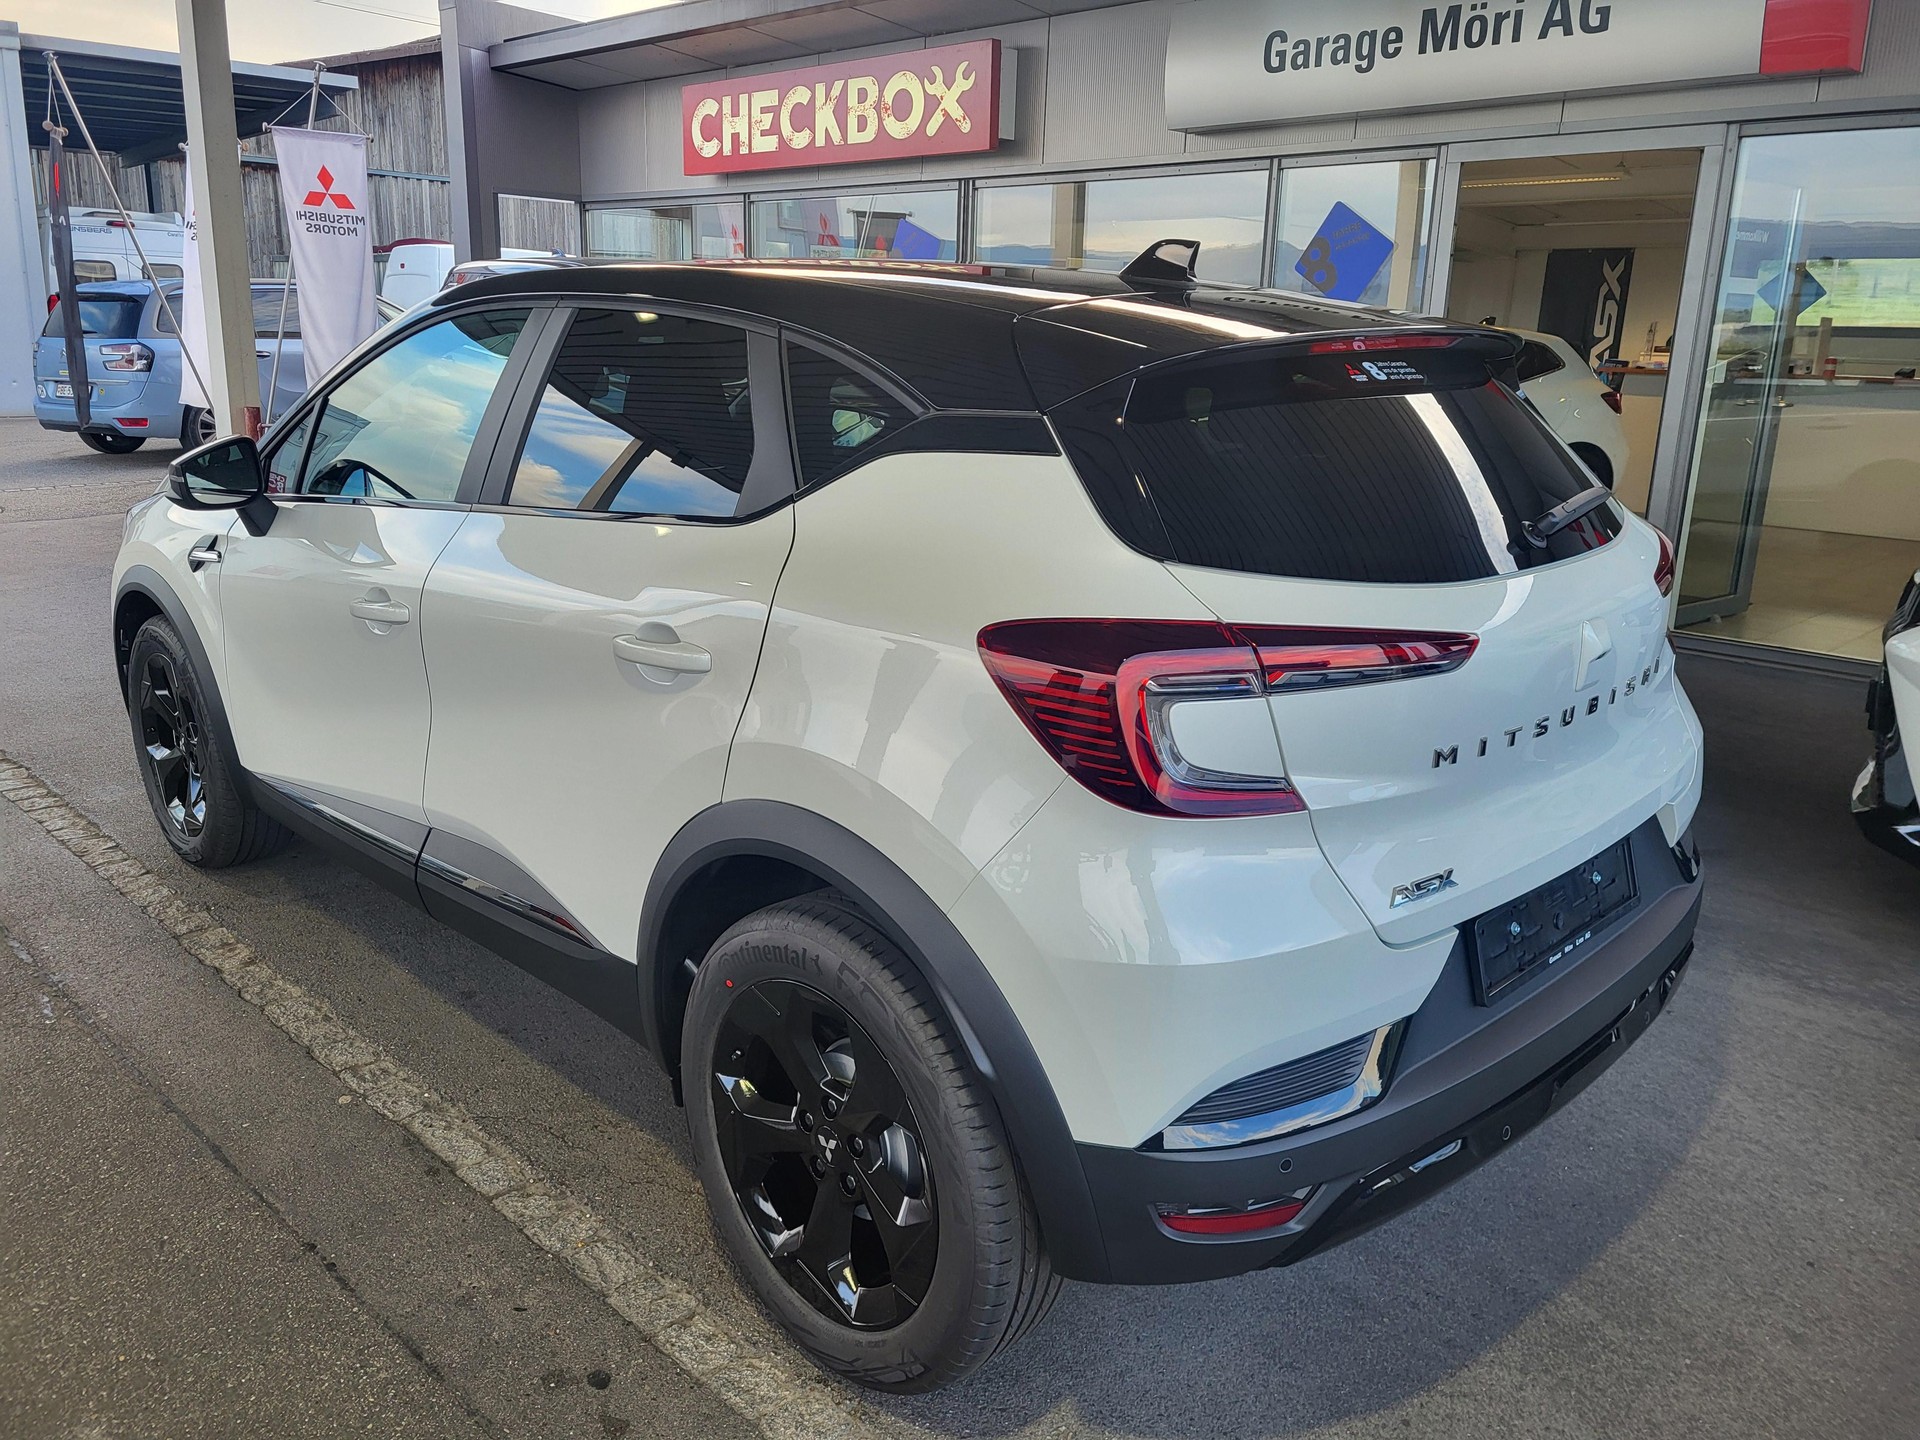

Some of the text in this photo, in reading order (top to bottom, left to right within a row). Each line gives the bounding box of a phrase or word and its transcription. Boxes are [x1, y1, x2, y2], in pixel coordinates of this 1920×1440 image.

[1263, 0, 1613, 74] Garage Möri AG
[691, 61, 976, 158] CHECKBOX
[1301, 236, 1337, 293] 8
[1589, 256, 1626, 371] ASX
[1362, 361, 1387, 380] 8
[1432, 656, 1661, 769] MITSUBISHI
[1389, 867, 1459, 909] ASX
[717, 940, 808, 971] Continental
